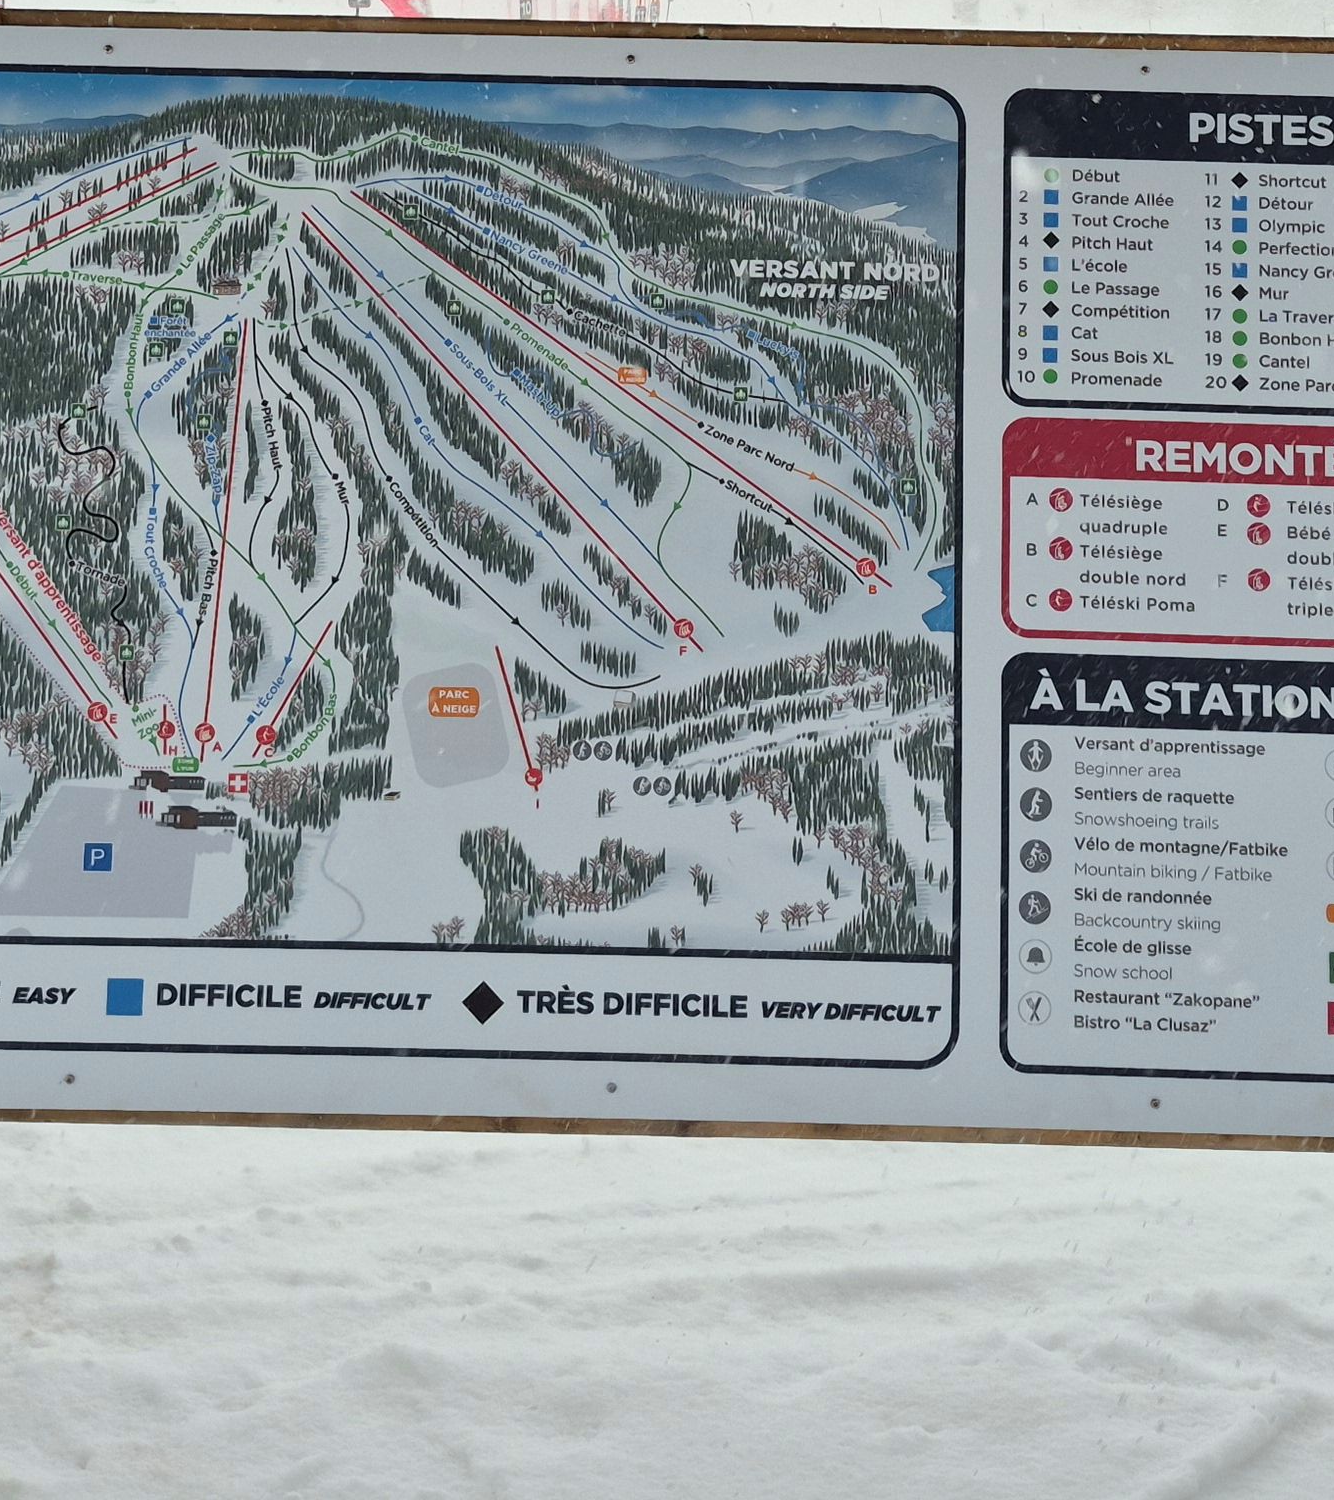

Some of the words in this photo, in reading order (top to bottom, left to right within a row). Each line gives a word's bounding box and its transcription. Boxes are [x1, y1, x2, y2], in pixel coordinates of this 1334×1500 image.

[1190, 113, 1334, 146] PISTES
[420, 138, 460, 154] Cantel
[1073, 169, 1120, 183] Début
[1259, 174, 1327, 188] Shortcut
[1072, 192, 1129, 205] Grande
[1134, 193, 1174, 206] Allée
[1259, 197, 1313, 211] Détour
[1072, 214, 1108, 227] Tout
[1113, 215, 1169, 229] Croche
[1259, 219, 1325, 236] Olympic
[180, 252, 193, 270] Le
[192, 212, 227, 255] Passage
[491, 229, 526, 256] Nancy
[528, 249, 568, 275] Greene
[729, 259, 855, 280] VERSANT
[864, 262, 940, 282] NORD
[1072, 258, 1127, 273] L'école
[70, 270, 123, 285] Traverse
[760, 282, 838, 299] NORTH
[839, 284, 890, 301] SIDE
[1259, 287, 1289, 300] Mur
[1072, 304, 1169, 320] Compétition
[574, 311, 627, 338] Cachette
[1071, 326, 1098, 340] Cat
[124, 343, 137, 391] Bonbon
[131, 313, 144, 342] Haut
[510, 320, 569, 372] Promenade
[151, 357, 188, 394] Grande
[186, 331, 212, 358] Allée
[1259, 355, 1309, 369] Cantel
[449, 342, 495, 393] Sous-Bois
[494, 389, 509, 408] XL
[1072, 372, 1162, 387] Promenade
[262, 406, 276, 439] Pitch
[419, 424, 435, 446] Cat
[267, 440, 283, 471] Haut
[703, 422, 736, 447] Zone
[736, 437, 762, 458] Parc
[765, 451, 796, 473] Nord
[335, 481, 350, 505] Mur
[725, 480, 773, 513] Shortcut
[1080, 494, 1163, 512] Télésiège
[388, 481, 439, 548] Compétition
[1080, 520, 1167, 537] quadruple
[1287, 526, 1331, 540] Bébé
[1080, 545, 1162, 562] Télésiège
[10, 565, 38, 599] Début
[1080, 570, 1140, 585] double
[1147, 573, 1186, 586] nord
[27, 558, 103, 664] d'apprentissage
[1079, 595, 1139, 610] Téléski
[1147, 598, 1195, 612] Poma
[1287, 602, 1334, 618] triple
[438, 688, 471, 701] PARC
[1030, 668, 1063, 710] À
[1075, 678, 1134, 712] LA
[430, 700, 441, 714] À
[442, 702, 478, 715] NEIGE
[291, 715, 330, 759] Bonbon
[324, 693, 338, 716] Bas
[1075, 736, 1135, 751] Versant
[1075, 762, 1143, 778] Beginner
[1148, 767, 1181, 778] area
[1075, 787, 1137, 801] Sentiers
[1142, 788, 1162, 802] de
[1168, 792, 1234, 806] raquette
[1075, 812, 1177, 831] Snowshoeing
[1183, 816, 1219, 829] trails
[1074, 836, 1109, 851] Vélo
[1115, 838, 1135, 852] de
[1140, 840, 1288, 857] montagne/Fatbike
[91, 849, 106, 866] P
[1075, 935, 1117, 953] École
[1122, 940, 1142, 953] de
[1147, 941, 1192, 957] glisse
[12, 987, 77, 1004] EASY
[157, 983, 302, 1008] DIFFICILE
[313, 992, 432, 1010] DIFFICULT
[517, 984, 594, 1015] TRÈS
[603, 992, 748, 1018] DIFFICILE
[761, 1001, 823, 1019] VERY
[824, 1003, 942, 1023] DIFFICULT
[1074, 989, 1160, 1005] Restaurant
[1074, 1015, 1120, 1030] Bistro
